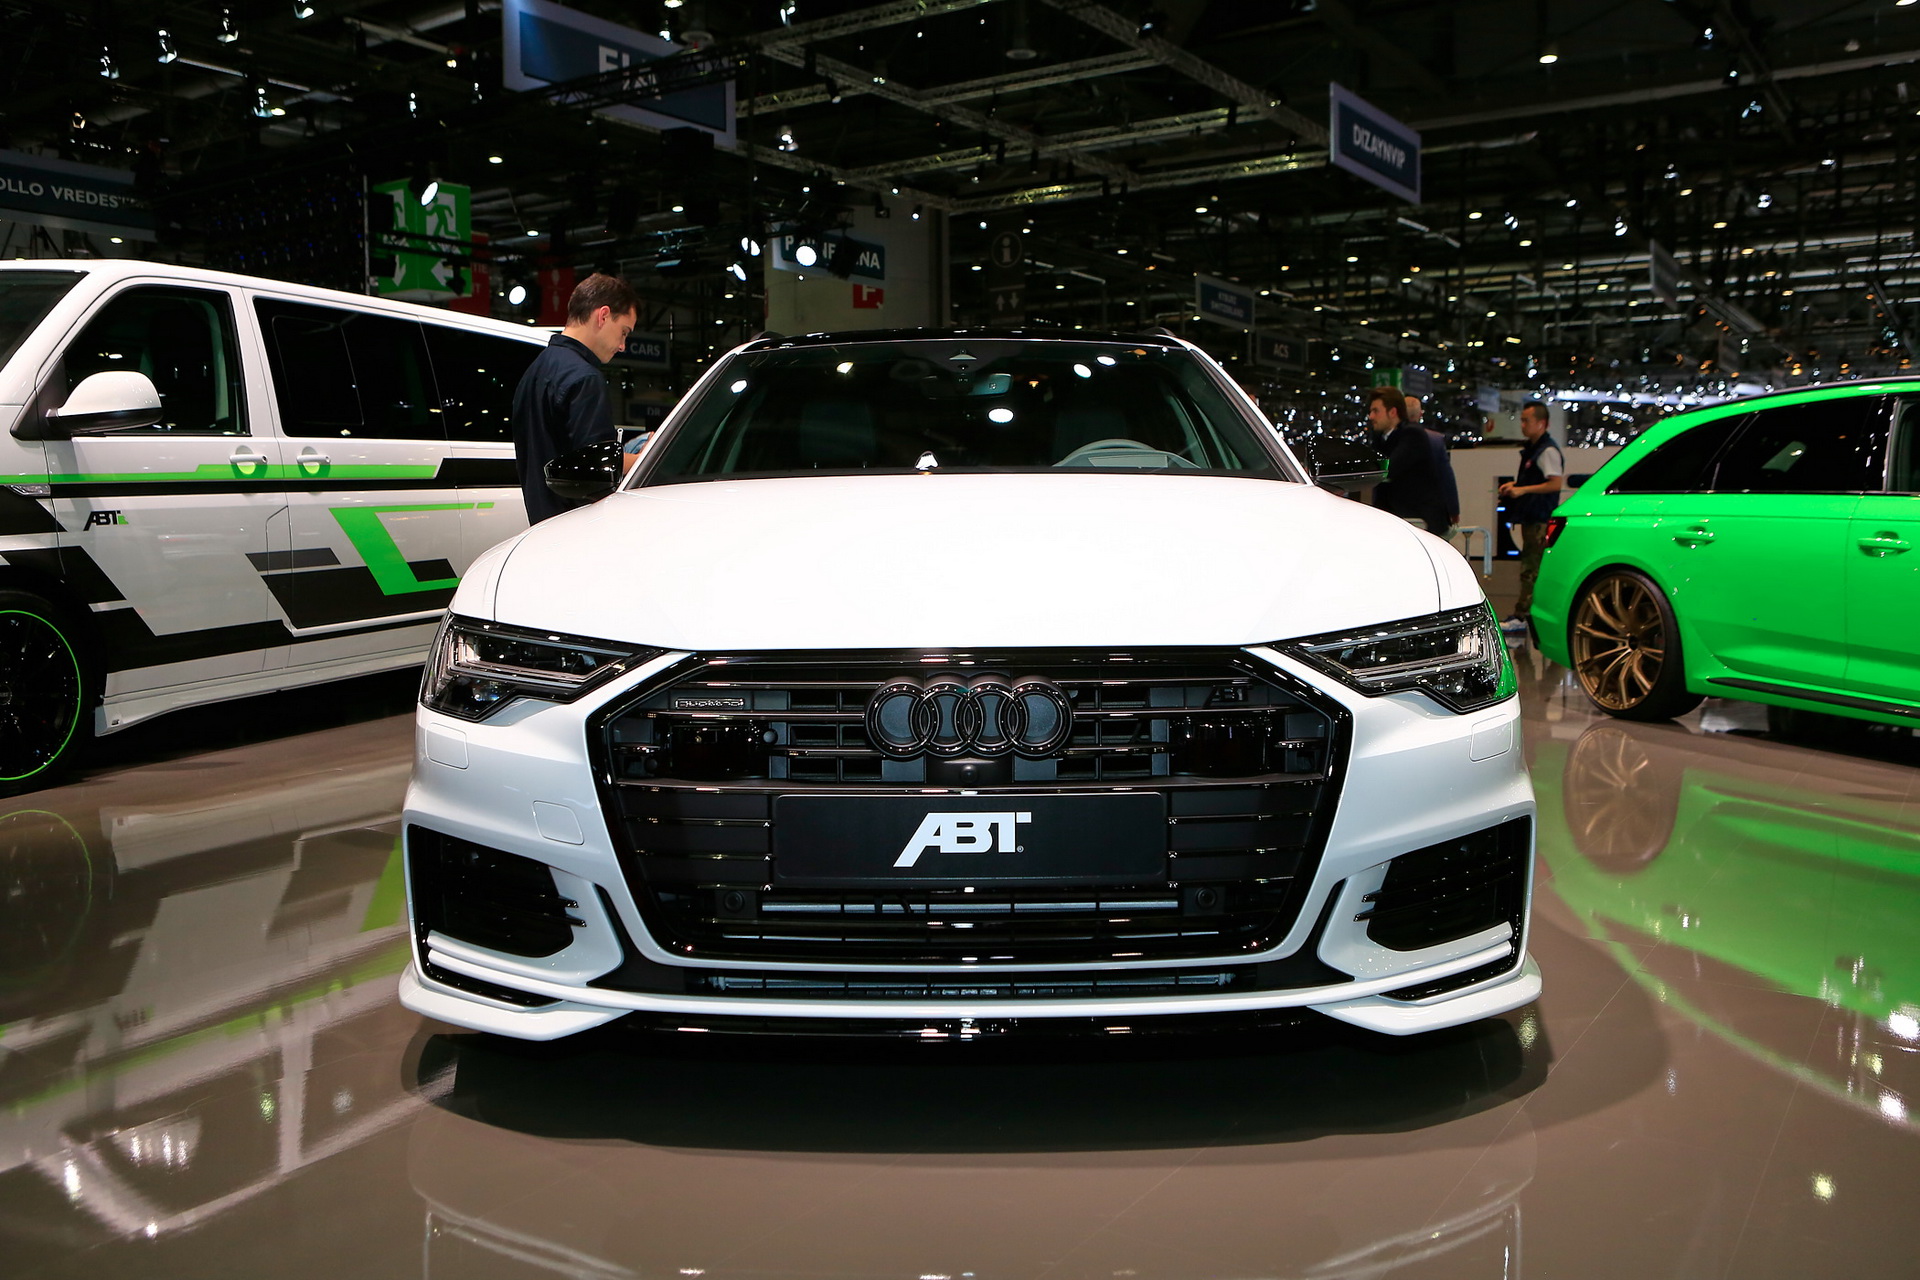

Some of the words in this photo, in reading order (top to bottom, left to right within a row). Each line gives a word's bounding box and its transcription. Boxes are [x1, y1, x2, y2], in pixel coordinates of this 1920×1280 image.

[1352, 122, 1406, 170] DIZAYNVIP
[51, 184, 144, 208] VREDES
[630, 341, 661, 357] CARS
[83, 510, 121, 531] ABT
[893, 811, 1032, 868] ABT
